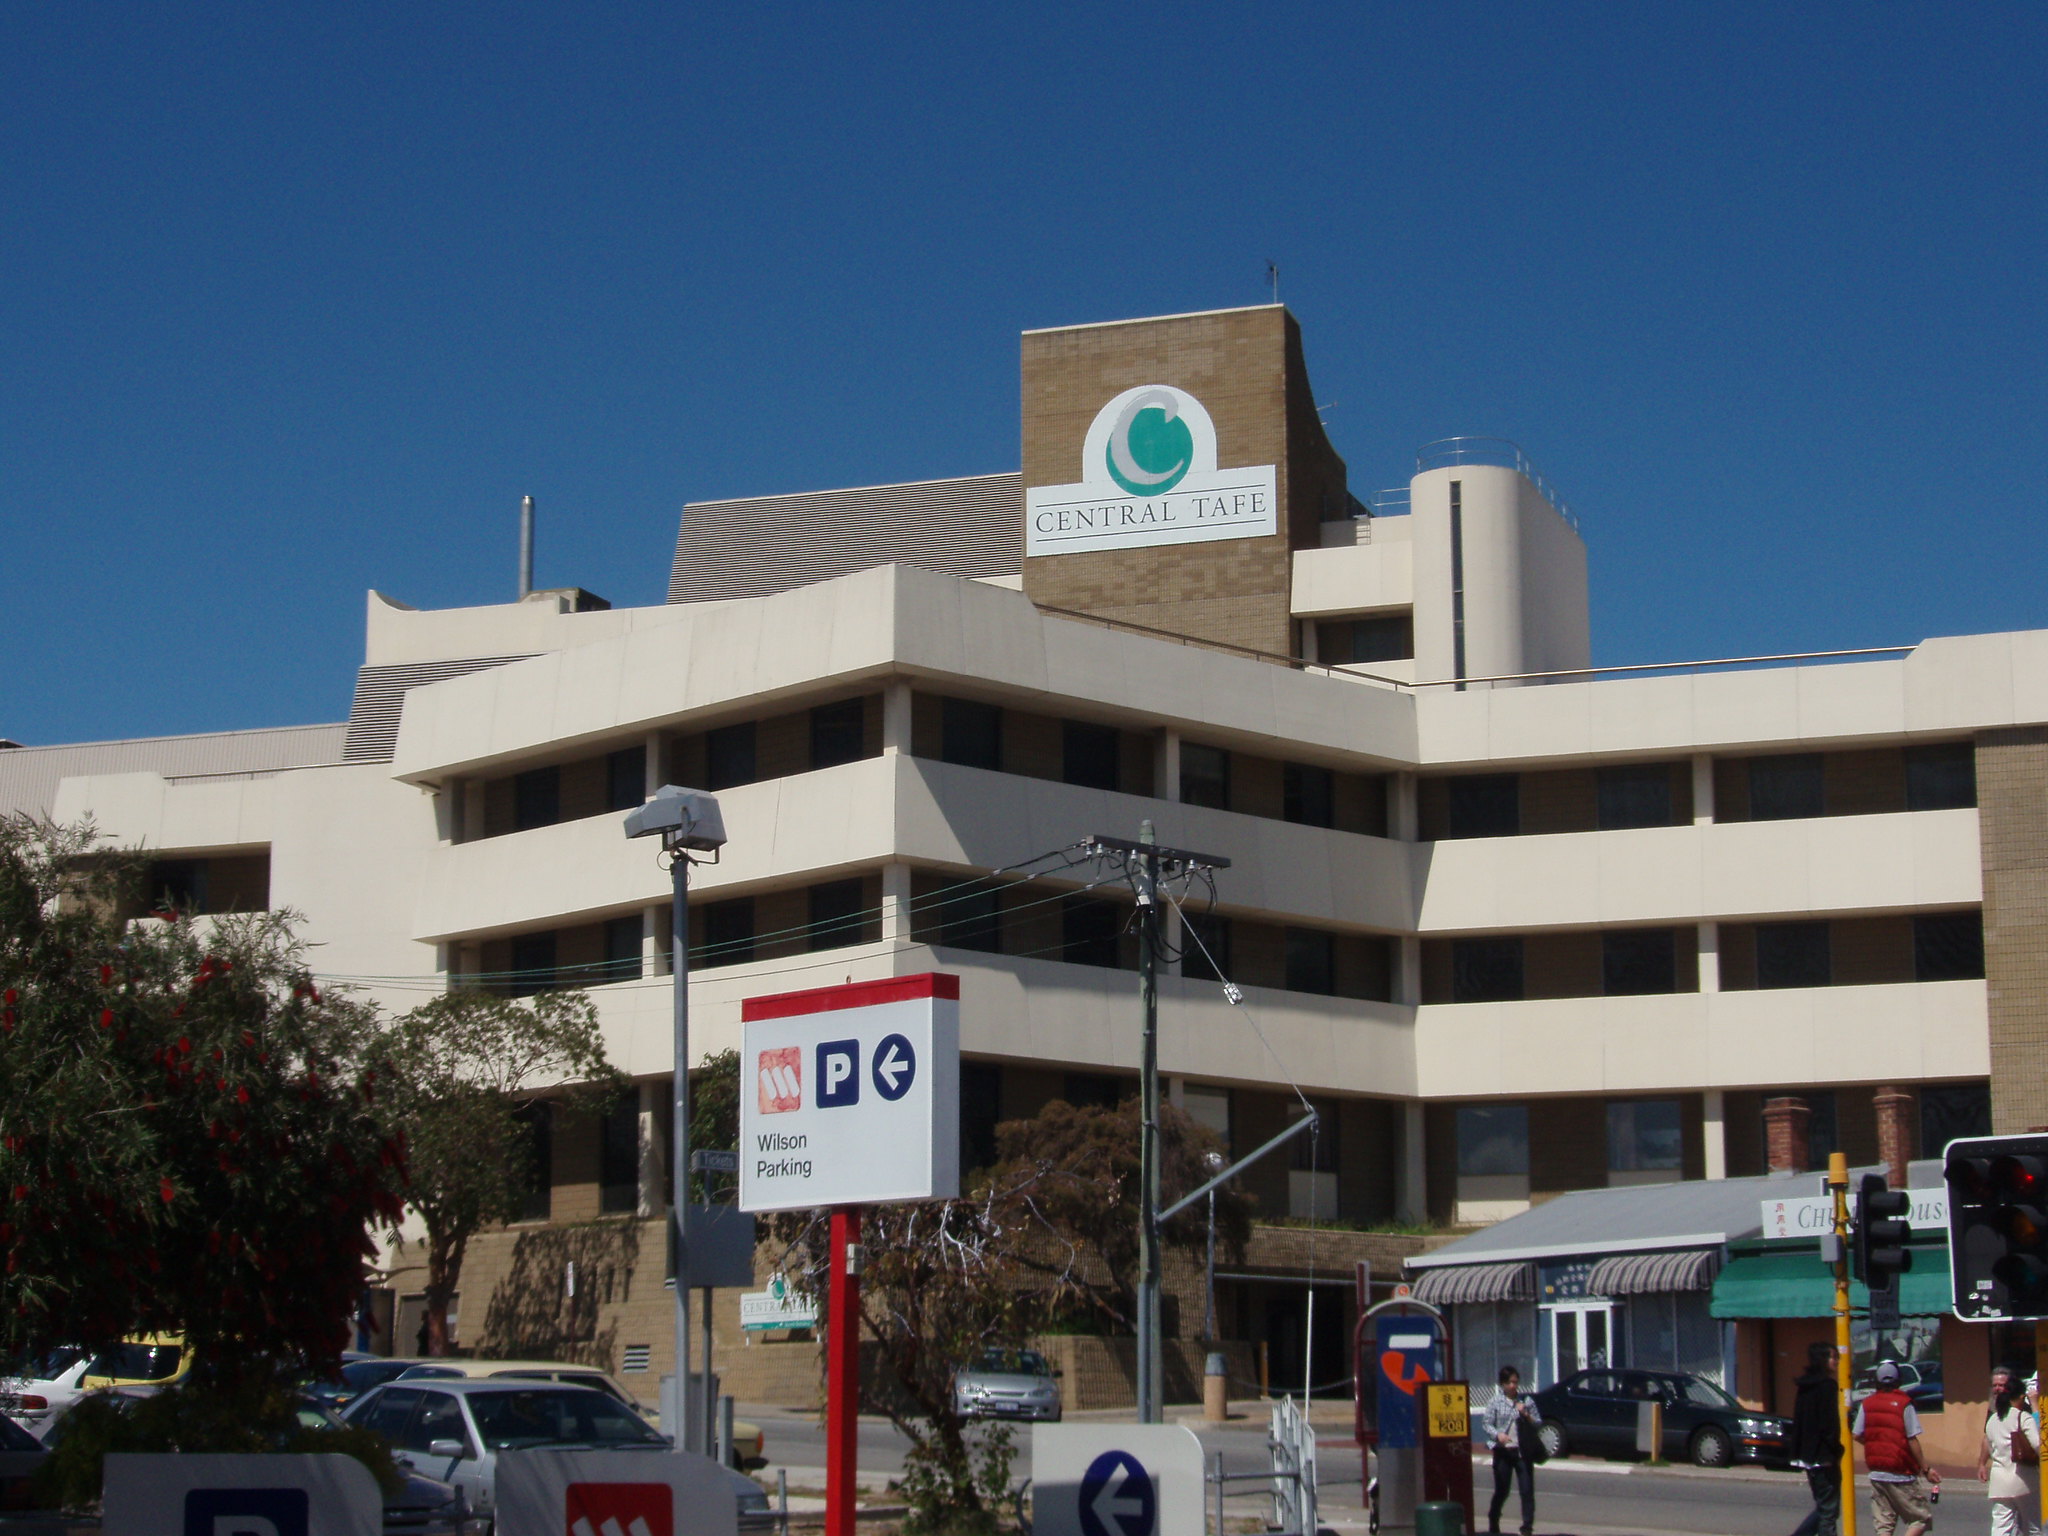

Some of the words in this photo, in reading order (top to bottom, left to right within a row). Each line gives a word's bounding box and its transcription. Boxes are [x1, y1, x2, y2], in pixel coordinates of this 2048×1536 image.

[1035, 501, 1177, 533] CENTRAL
[1191, 492, 1267, 519] TAFE
[825, 1052, 851, 1095] P
[757, 1132, 808, 1153] Wilson
[756, 1157, 812, 1179] Parking
[743, 1301, 785, 1314] CENTRA
[1440, 1420, 1462, 1432] 208
